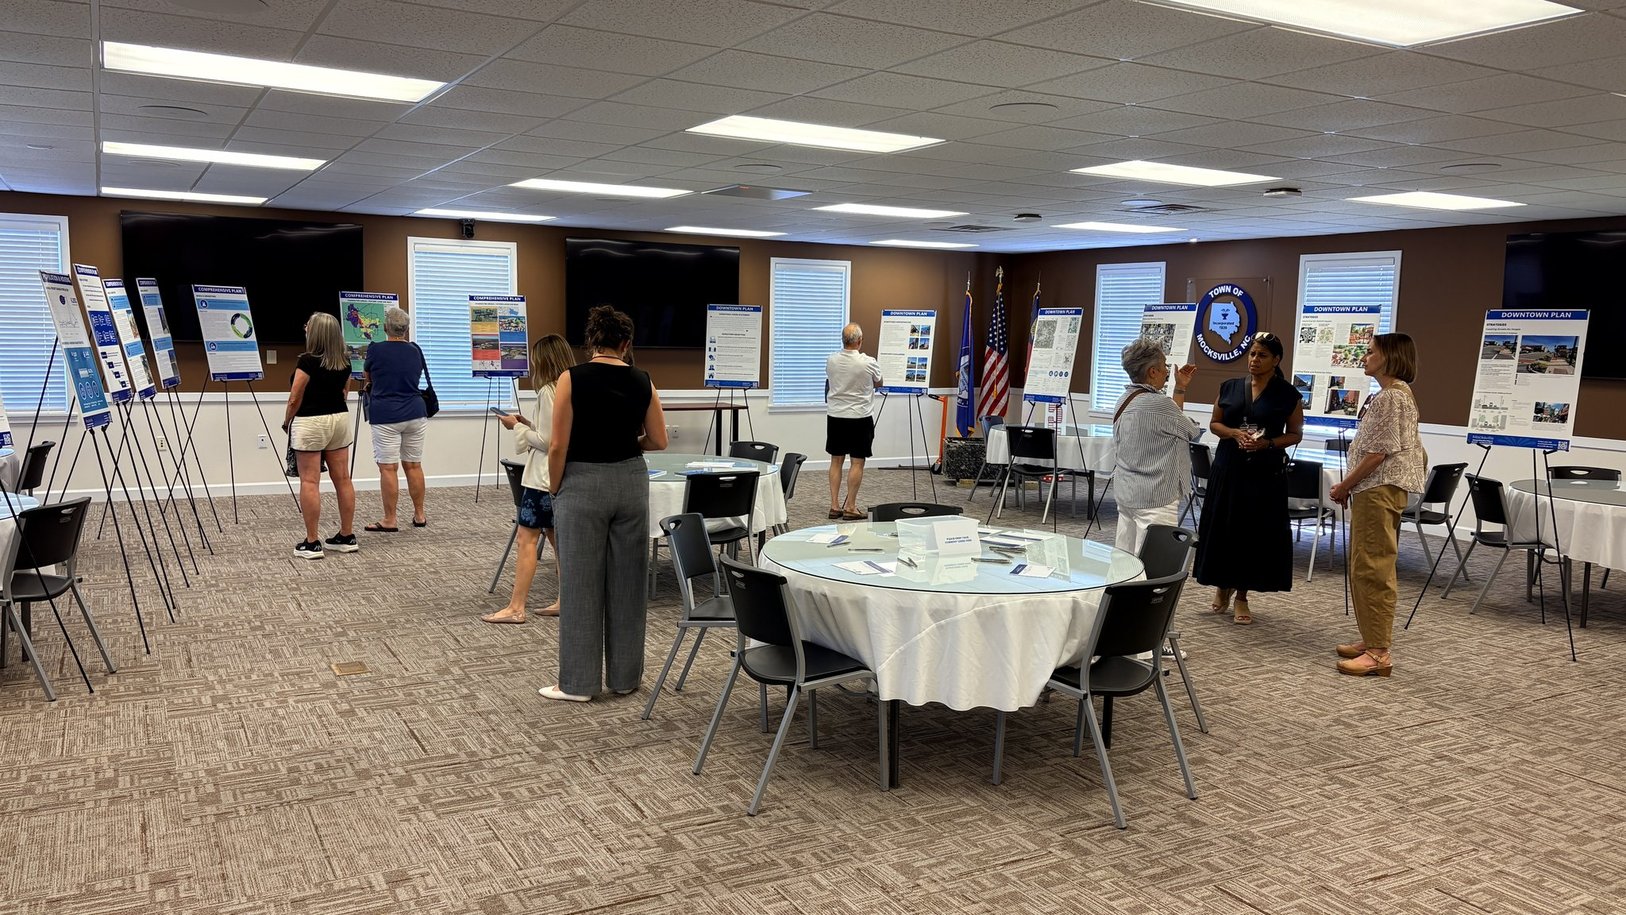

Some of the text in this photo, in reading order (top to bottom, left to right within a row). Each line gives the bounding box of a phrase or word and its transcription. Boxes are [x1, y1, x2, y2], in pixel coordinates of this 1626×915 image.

[1209, 286, 1244, 298] TOWN OF
[1196, 334, 1250, 360] MOCKSVILLE, NC
